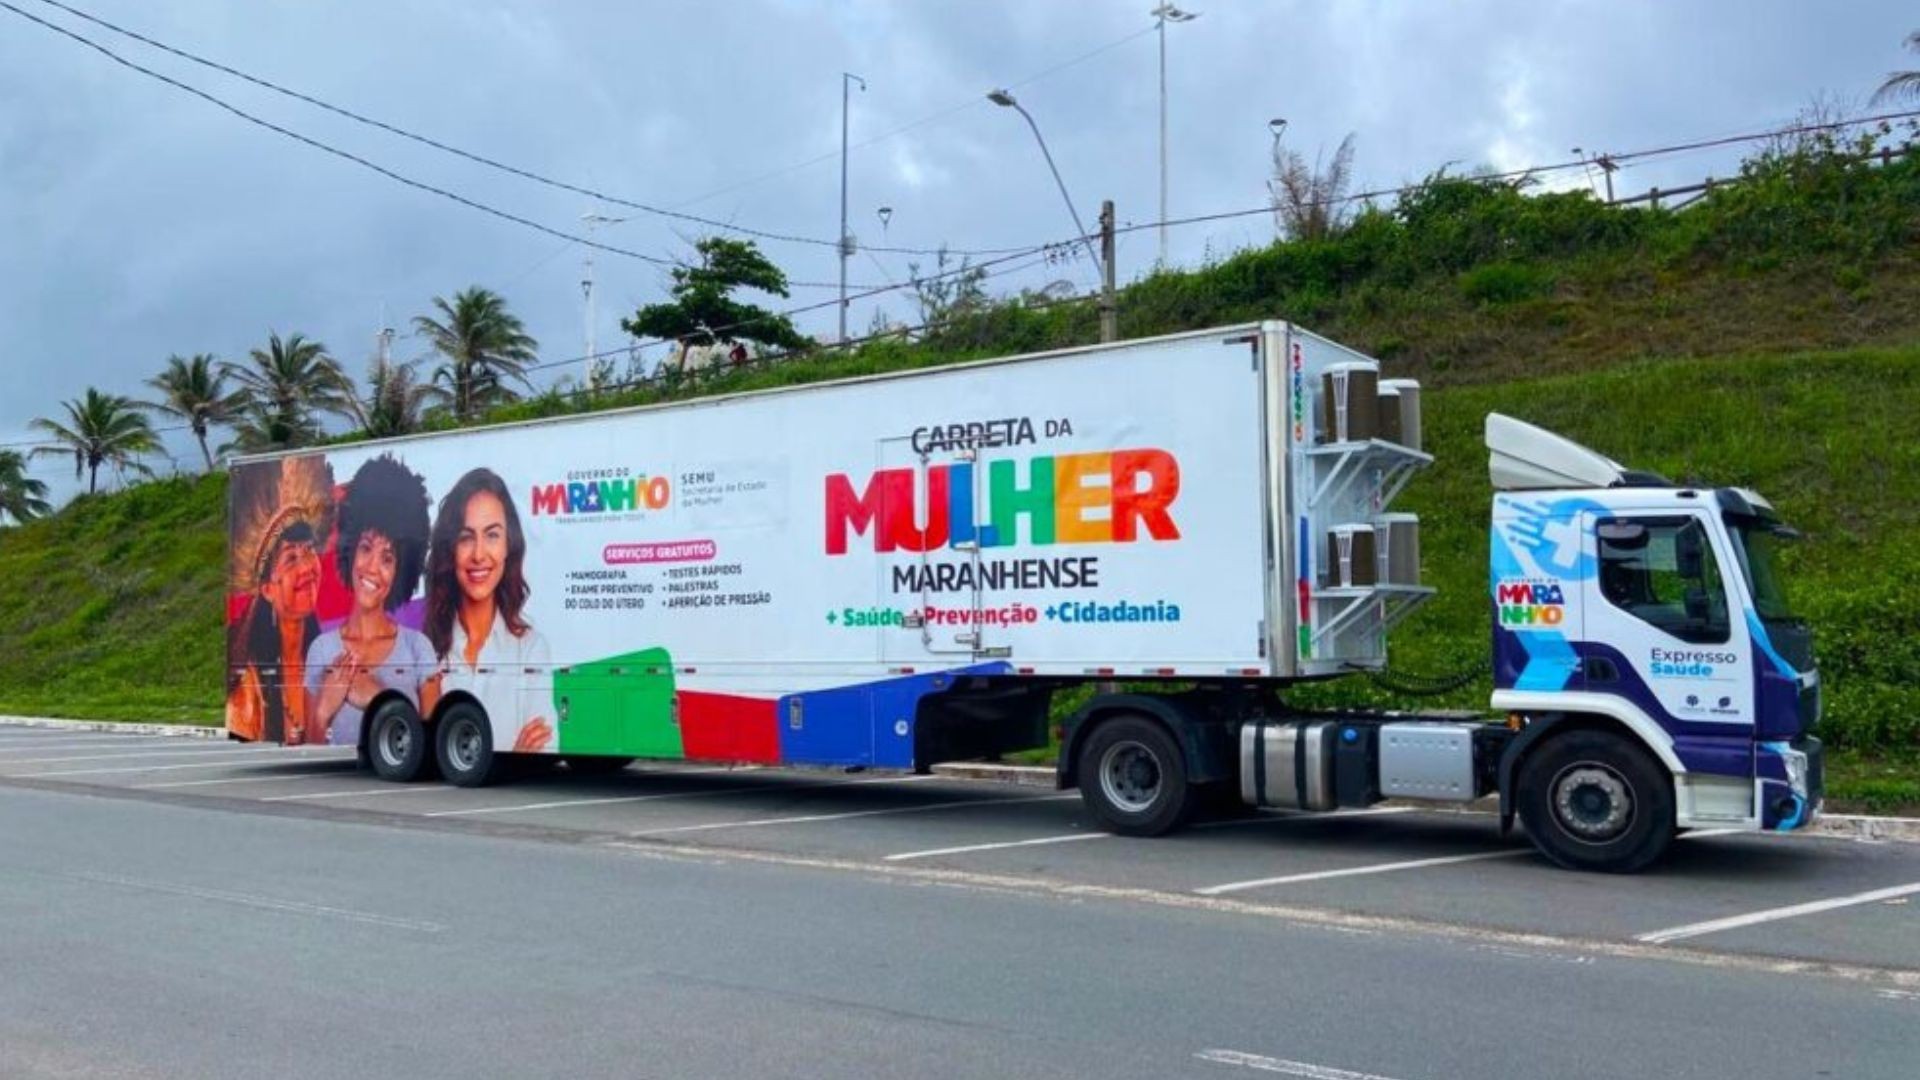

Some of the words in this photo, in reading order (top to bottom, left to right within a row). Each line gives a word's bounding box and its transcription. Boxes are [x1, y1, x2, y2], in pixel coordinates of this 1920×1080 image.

[911, 417, 1036, 453] CARRETA
[1045, 418, 1073, 438] DA
[681, 471, 715, 485] SEMU
[531, 474, 670, 516] MARANHÃO
[825, 447, 1181, 555] MULHER
[606, 547, 655, 560] SERVIÇOS
[656, 543, 713, 558] GRATUITOS
[571, 571, 627, 580] MAMOGRAFIA
[669, 567, 700, 578] TESTES
[893, 557, 1098, 594] MARANHENSE
[571, 584, 599, 594] EXAME
[601, 583, 654, 594] PREVENTIVO
[668, 580, 719, 592] PALESTRAS
[1499, 584, 1565, 604] MARA
[565, 598, 577, 609] DO
[579, 598, 600, 609] COLO
[602, 598, 614, 609] DO
[714, 594, 727, 606] DE
[728, 590, 772, 606] PRESSÃO
[843, 606, 904, 627] Saúde
[1651, 648, 1737, 664] Expresso
